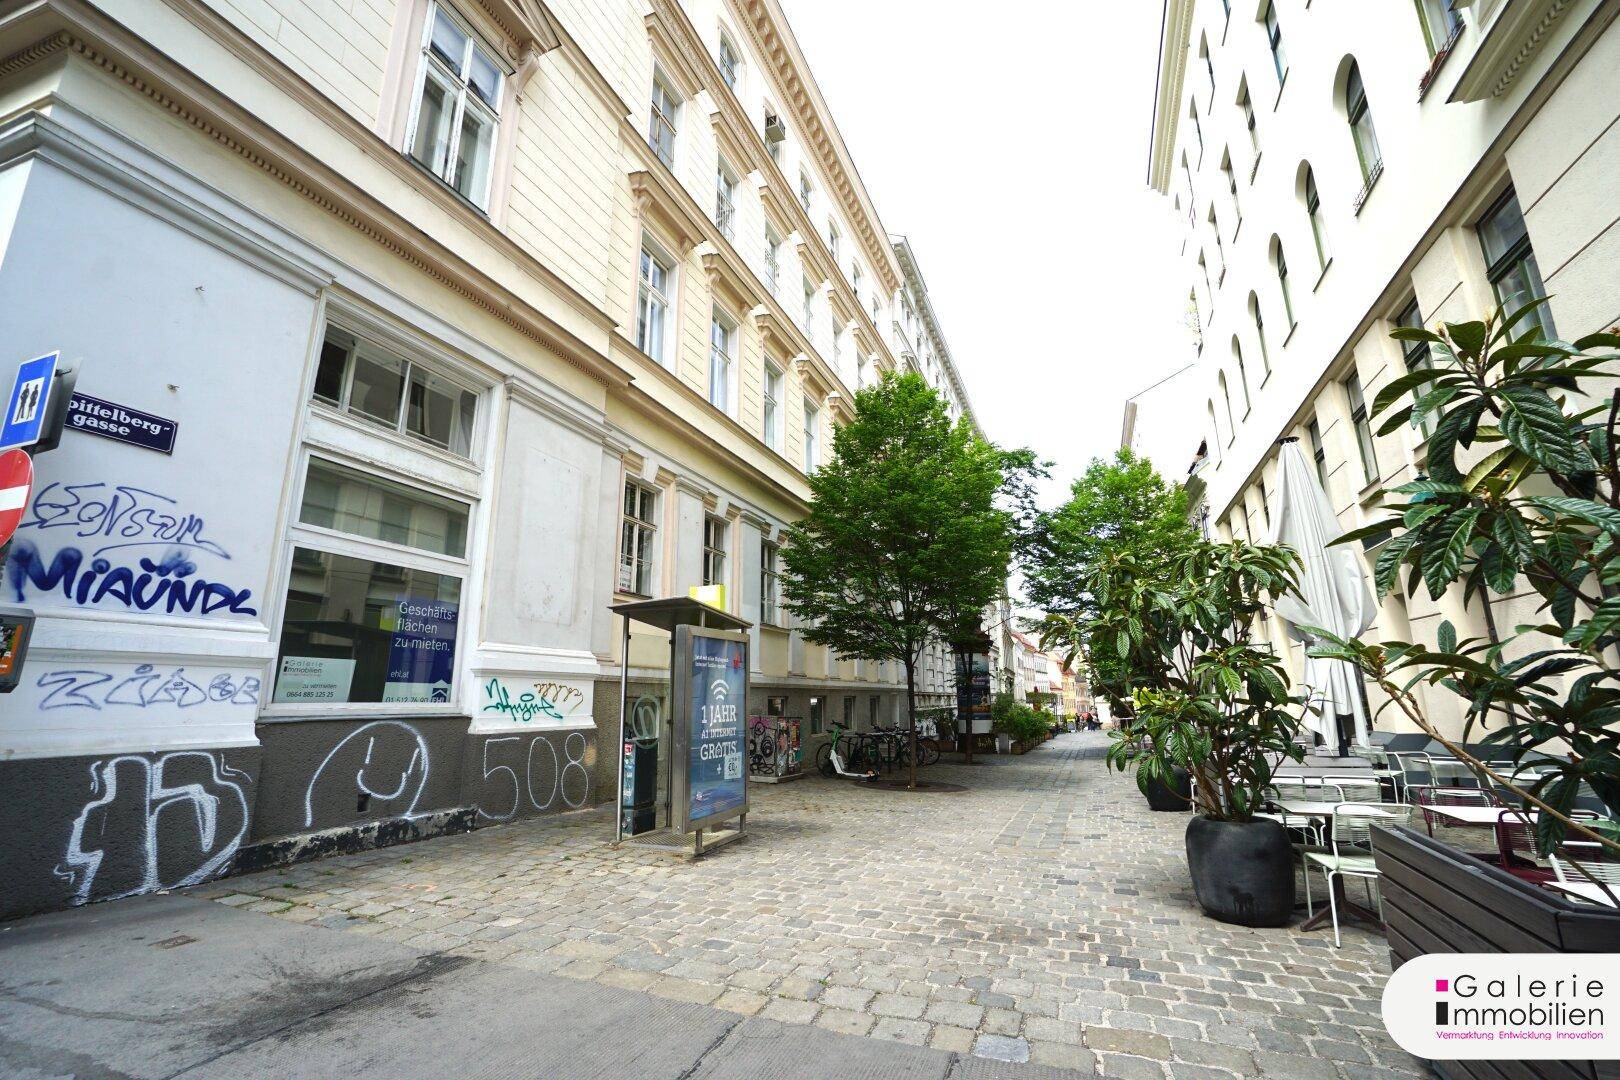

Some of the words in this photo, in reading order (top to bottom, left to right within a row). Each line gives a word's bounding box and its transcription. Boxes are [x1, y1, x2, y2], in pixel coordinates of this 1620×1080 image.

[68, 400, 170, 435] pittelberg-
[73, 414, 130, 436] gasse
[399, 601, 456, 620] Geschäfts-
[397, 618, 438, 634] flächen
[395, 638, 408, 648] zu
[411, 638, 450, 651] mieten.
[701, 705, 708, 724] 1
[710, 704, 737, 727] JAHR
[710, 727, 737, 738] INTERNET
[478, 732, 589, 821] 508
